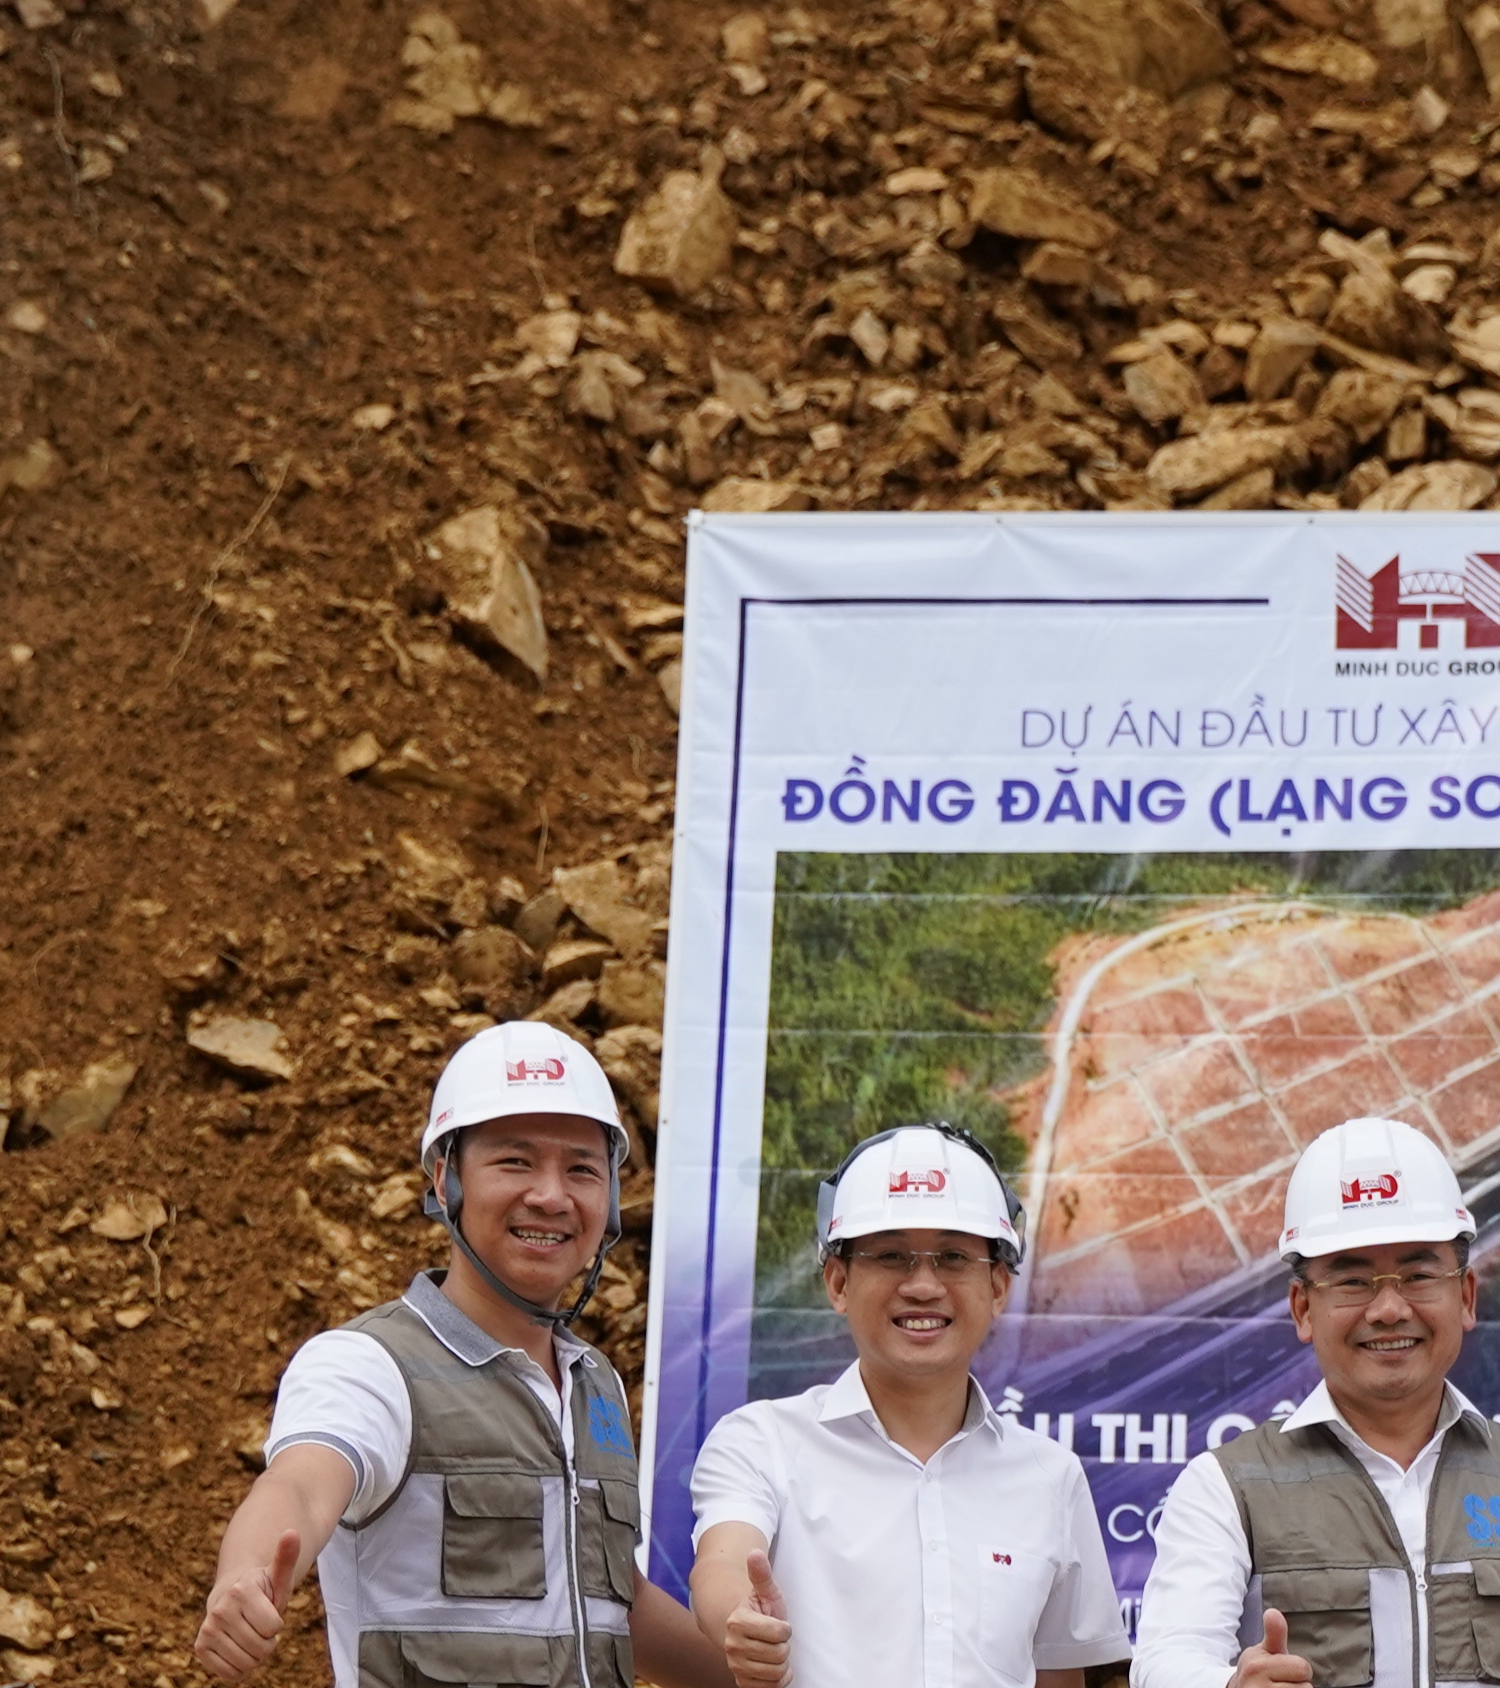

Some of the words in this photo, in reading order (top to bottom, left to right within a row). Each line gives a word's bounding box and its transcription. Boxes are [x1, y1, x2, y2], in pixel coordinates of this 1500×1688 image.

[1334, 661, 1388, 678] MINH
[1396, 661, 1440, 677] DUC
[1021, 704, 1094, 757] DỰ
[1107, 699, 1181, 748] ÁN
[1199, 694, 1309, 748] ĐẦU
[1326, 703, 1384, 747] TƯ
[1398, 699, 1499, 747] XÂY
[781, 754, 976, 825] ĐỒNG
[996, 766, 1187, 824] ĐĂNG
[1208, 776, 1409, 838] (LẠNG
[1091, 1413, 1188, 1464] THI
